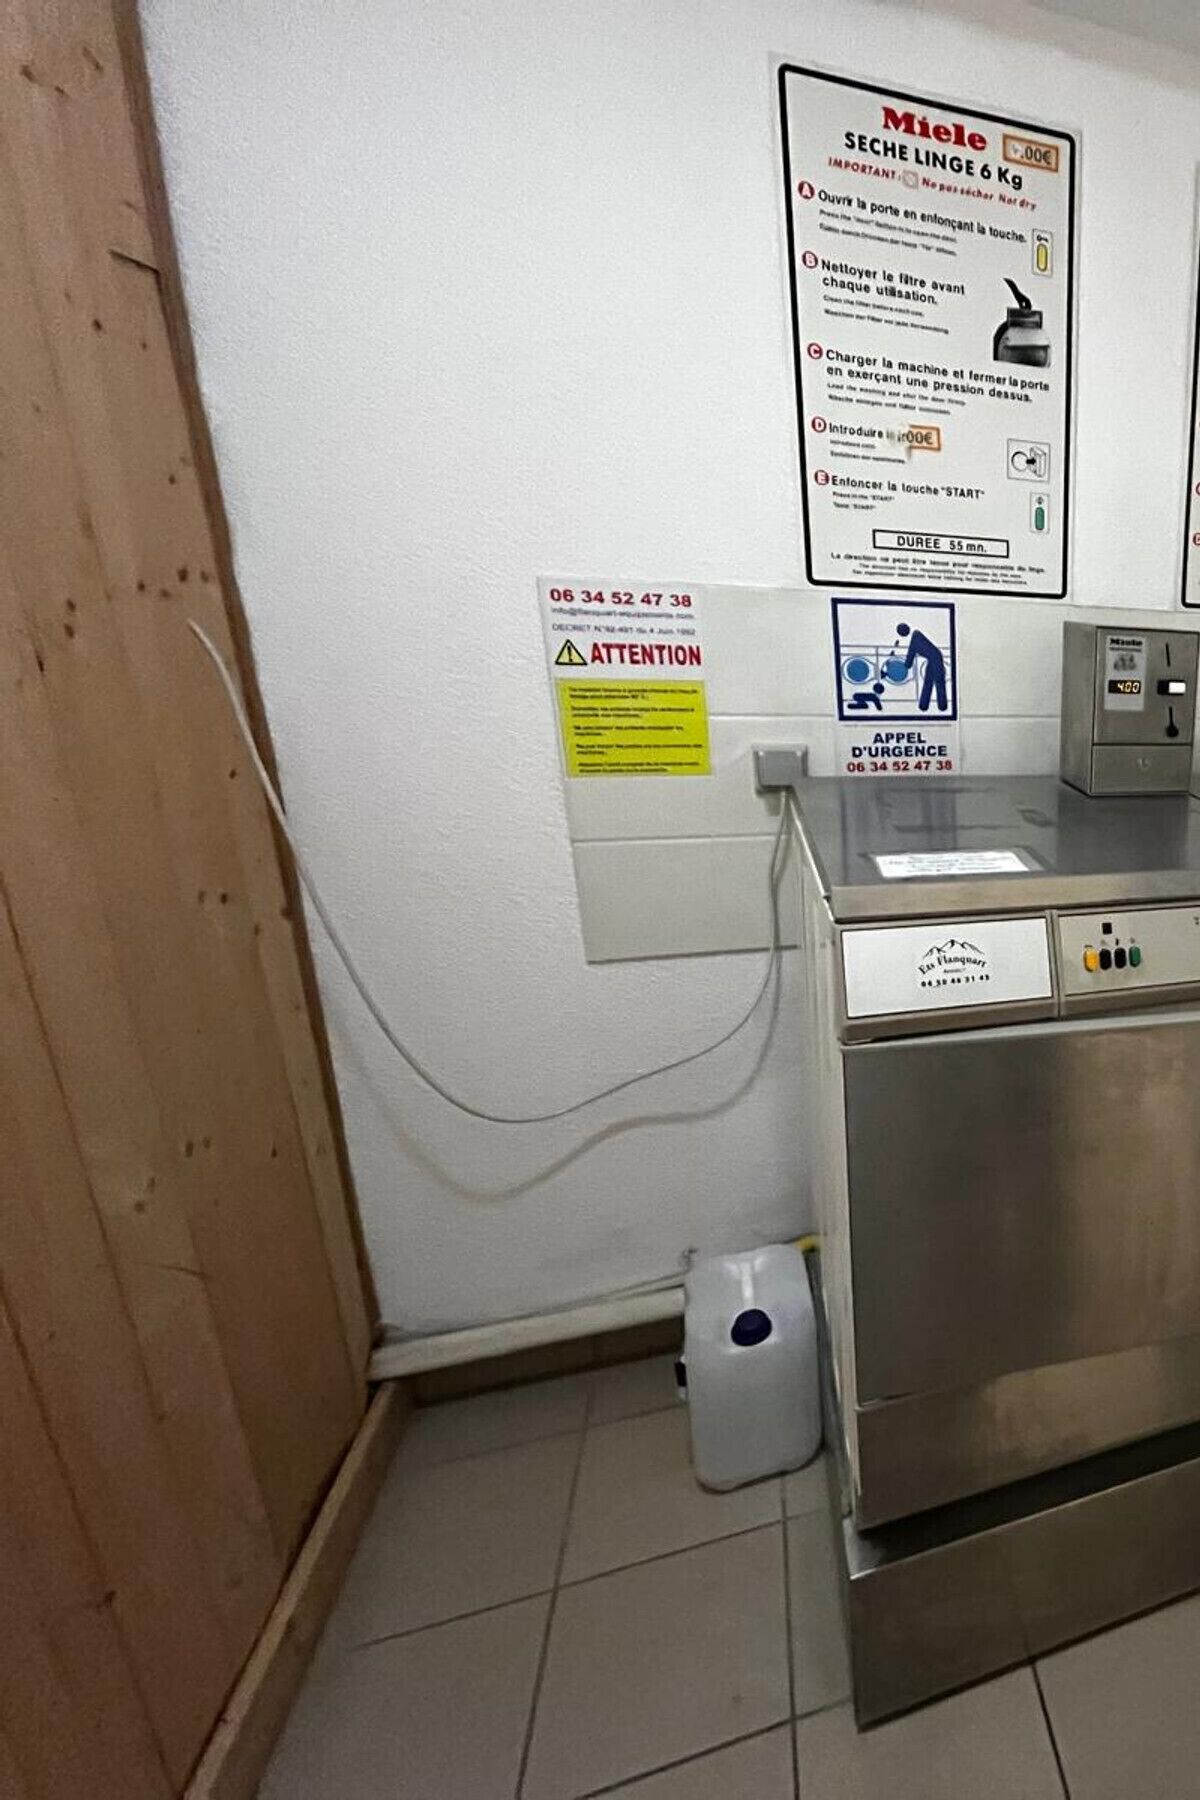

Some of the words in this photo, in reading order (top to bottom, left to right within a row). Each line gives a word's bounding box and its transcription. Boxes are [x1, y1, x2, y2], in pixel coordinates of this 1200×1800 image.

[881, 105, 988, 152] Miele
[844, 131, 909, 162] SECHE
[914, 147, 975, 177] LINGE
[980, 160, 992, 180] 6
[997, 166, 1023, 190] Kg
[1011, 143, 1053, 166] .00€
[828, 156, 897, 181] IMPORTANT
[856, 197, 867, 211] la
[870, 200, 900, 219] porte
[903, 206, 918, 221] en
[920, 210, 974, 235] enfonçant
[976, 221, 987, 236] la
[989, 225, 1027, 244] touche.
[821, 259, 878, 280] Nettoyer
[883, 270, 894, 283] le
[899, 271, 926, 289] filtre
[931, 280, 966, 296] avant
[823, 276, 870, 296] chaque
[876, 284, 938, 305] utilisation.
[827, 350, 877, 371] Charger
[882, 357, 893, 370] la
[898, 360, 948, 378] machine
[952, 367, 964, 380] et
[969, 370, 1007, 387] fermer
[1009, 376, 1019, 388] la
[1020, 378, 1050, 394] porte
[827, 364, 843, 377] en
[847, 367, 901, 387] exerçant
[906, 375, 929, 388] une
[933, 378, 985, 396] pression
[989, 385, 1033, 403] dessus.
[829, 421, 884, 440] Introduire
[831, 475, 883, 491] Enfoncer
[886, 480, 897, 492] la
[901, 482, 939, 497] touche
[896, 535, 941, 550] DUREE
[949, 541, 963, 552] 55
[550, 588, 575, 602] 06
[581, 590, 605, 604] 34
[611, 592, 635, 605] 52
[640, 593, 663, 606] 47
[669, 594, 693, 608] 38
[590, 642, 702, 666] ATTENTION
[873, 732, 927, 744] APPEL
[851, 745, 948, 758] D'URGENCE
[847, 761, 866, 773] 06
[870, 761, 888, 772] 34
[892, 761, 910, 772] 52
[914, 760, 931, 771] 47
[935, 760, 953, 771] 38
[937, 954, 987, 968] Flanquart
